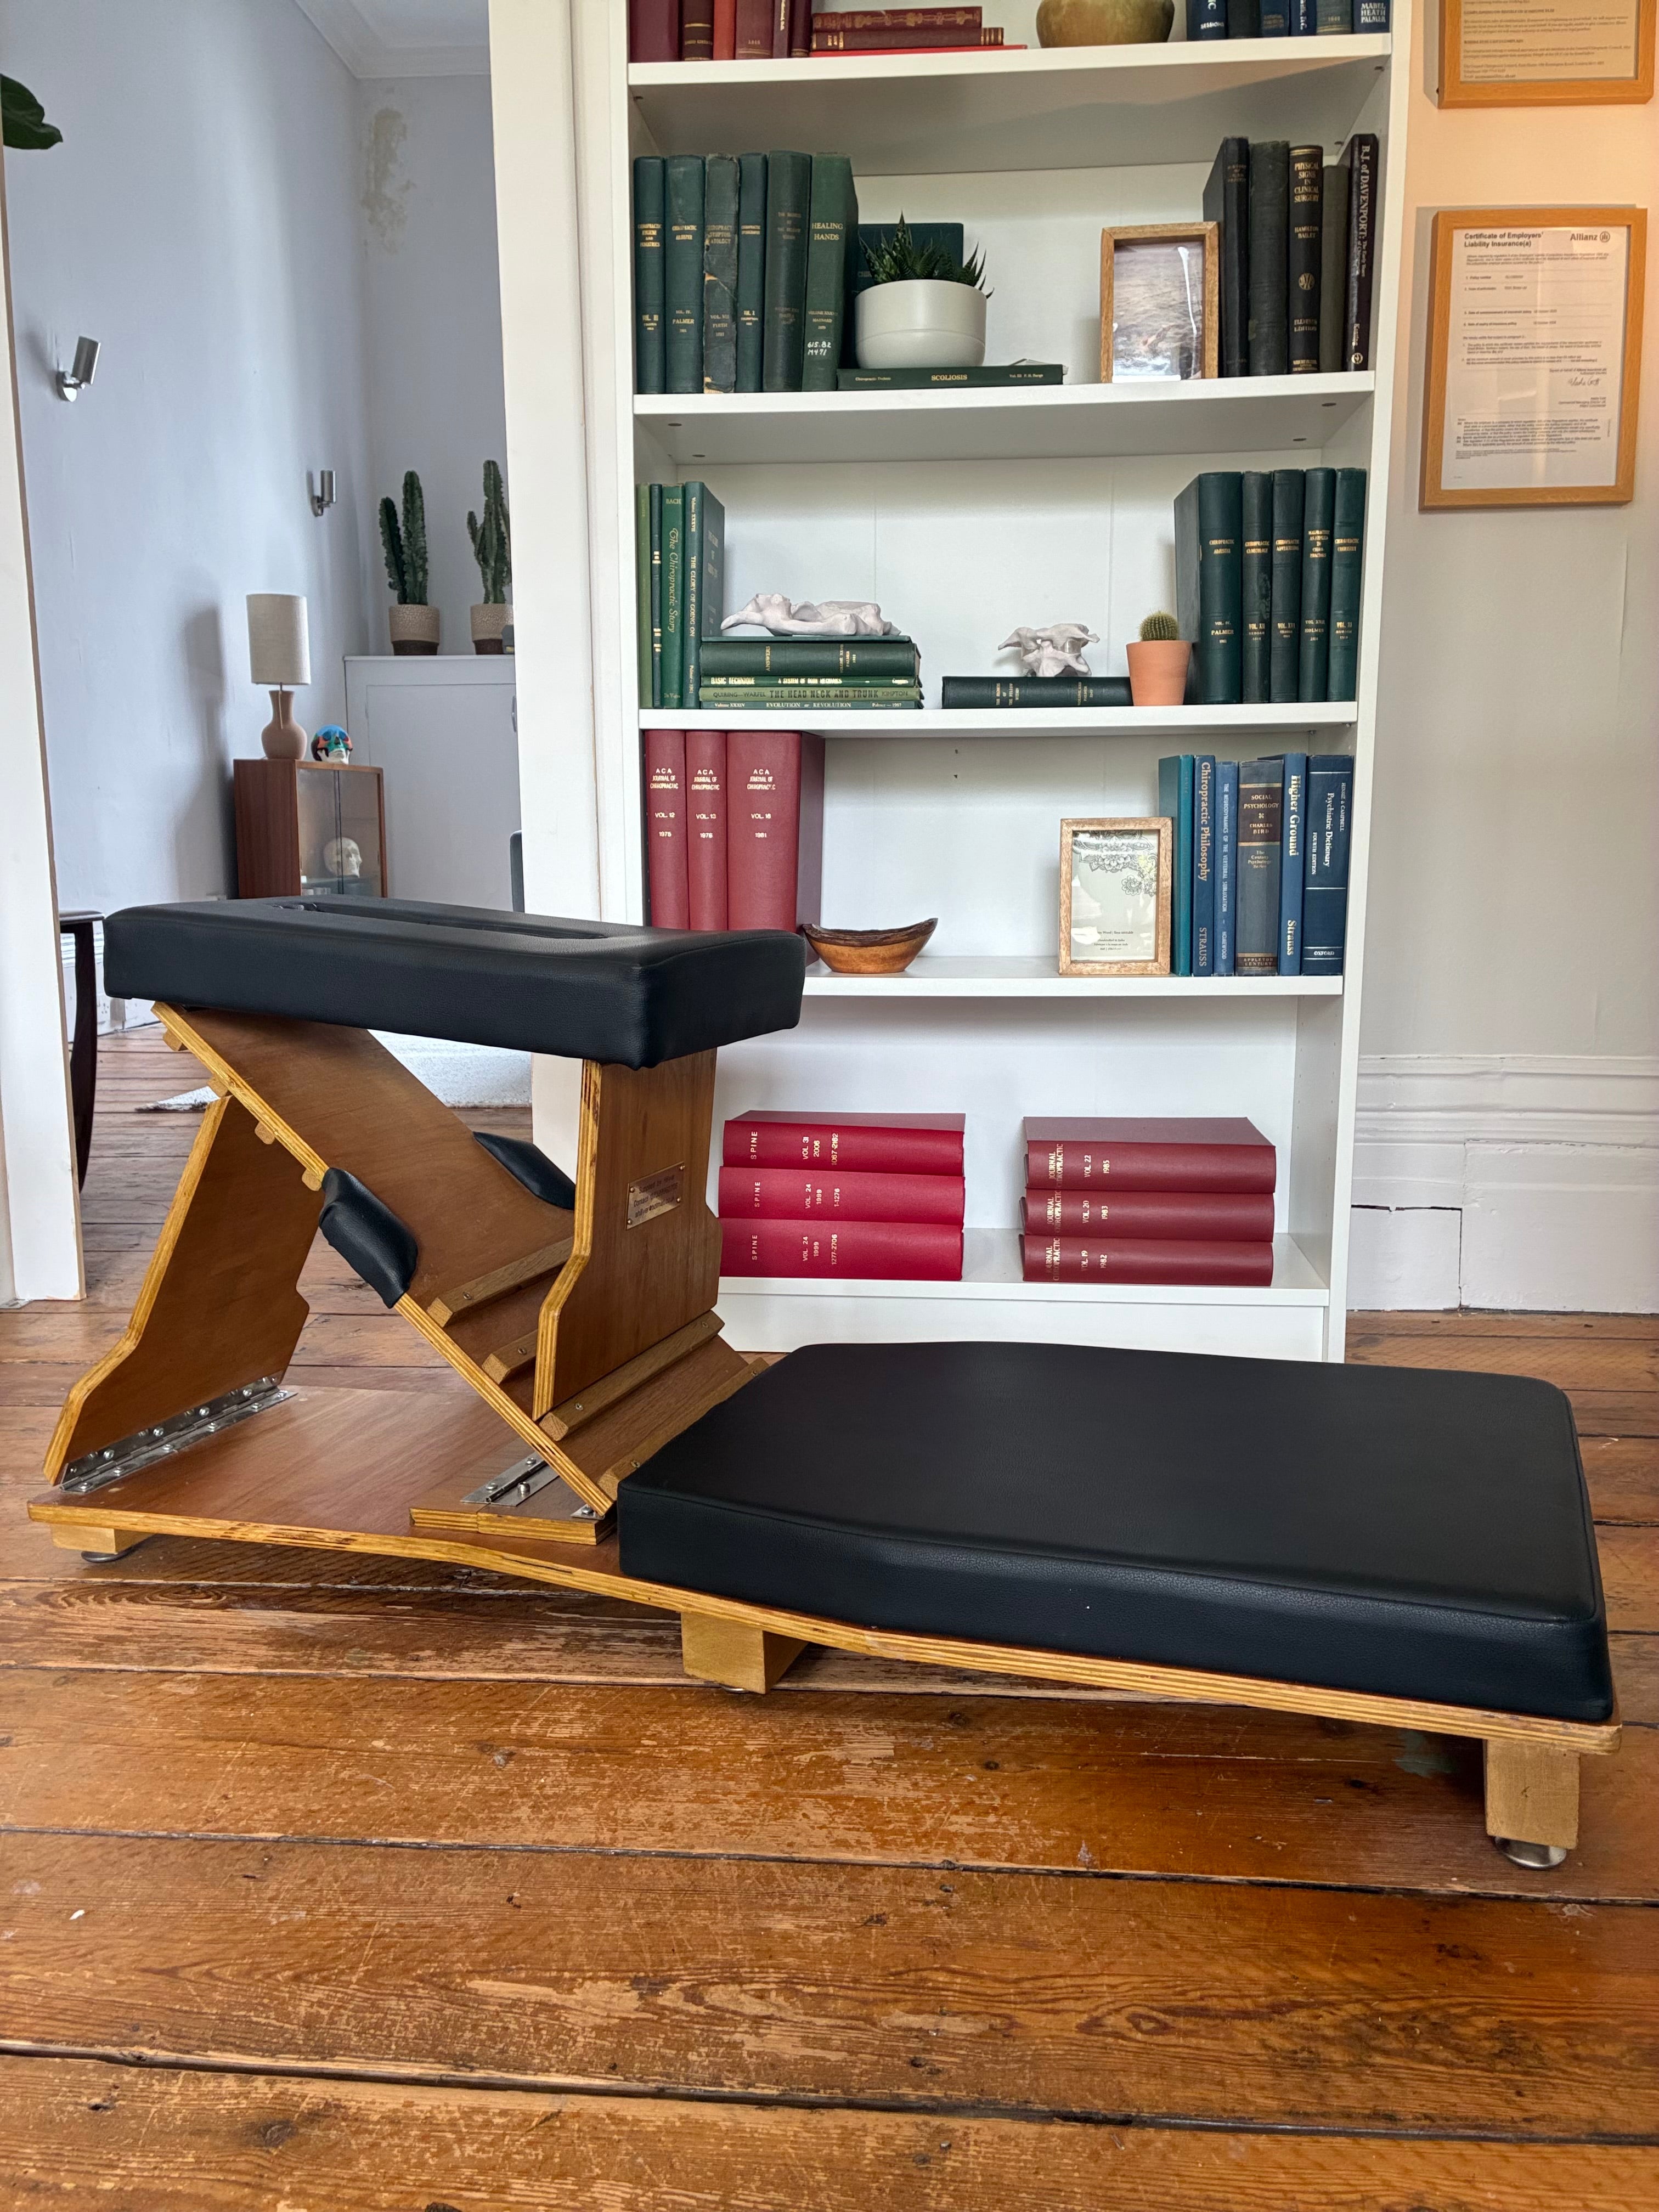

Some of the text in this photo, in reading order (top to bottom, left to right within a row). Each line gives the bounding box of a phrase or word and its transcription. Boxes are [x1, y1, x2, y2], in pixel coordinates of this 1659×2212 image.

[1294, 162, 1319, 171] PHYSICAL
[1361, 165, 1369, 174] of
[1294, 194, 1319, 202] SURGERY
[668, 528, 679, 633] The Chiropractic Story
[690, 593, 696, 602] OF
[689, 627, 695, 637] ON
[770, 690, 784, 698] THE
[788, 690, 807, 698] HEAD
[810, 690, 831, 698] NECK
[834, 690, 849, 698] AND
[853, 690, 878, 698] TRUNK
[1199, 761, 1211, 825] Chiropractic
[1323, 792, 1335, 867] Psychiatric Dictionary
[1198, 827, 1210, 881] Philosophy
[1287, 775, 1301, 956] Higher Ground Strauss
[1084, 1155, 1091, 1163] 22
[805, 1183, 811, 1193] 24
[1082, 1200, 1090, 1209] 20
[803, 1235, 808, 1245] 24
